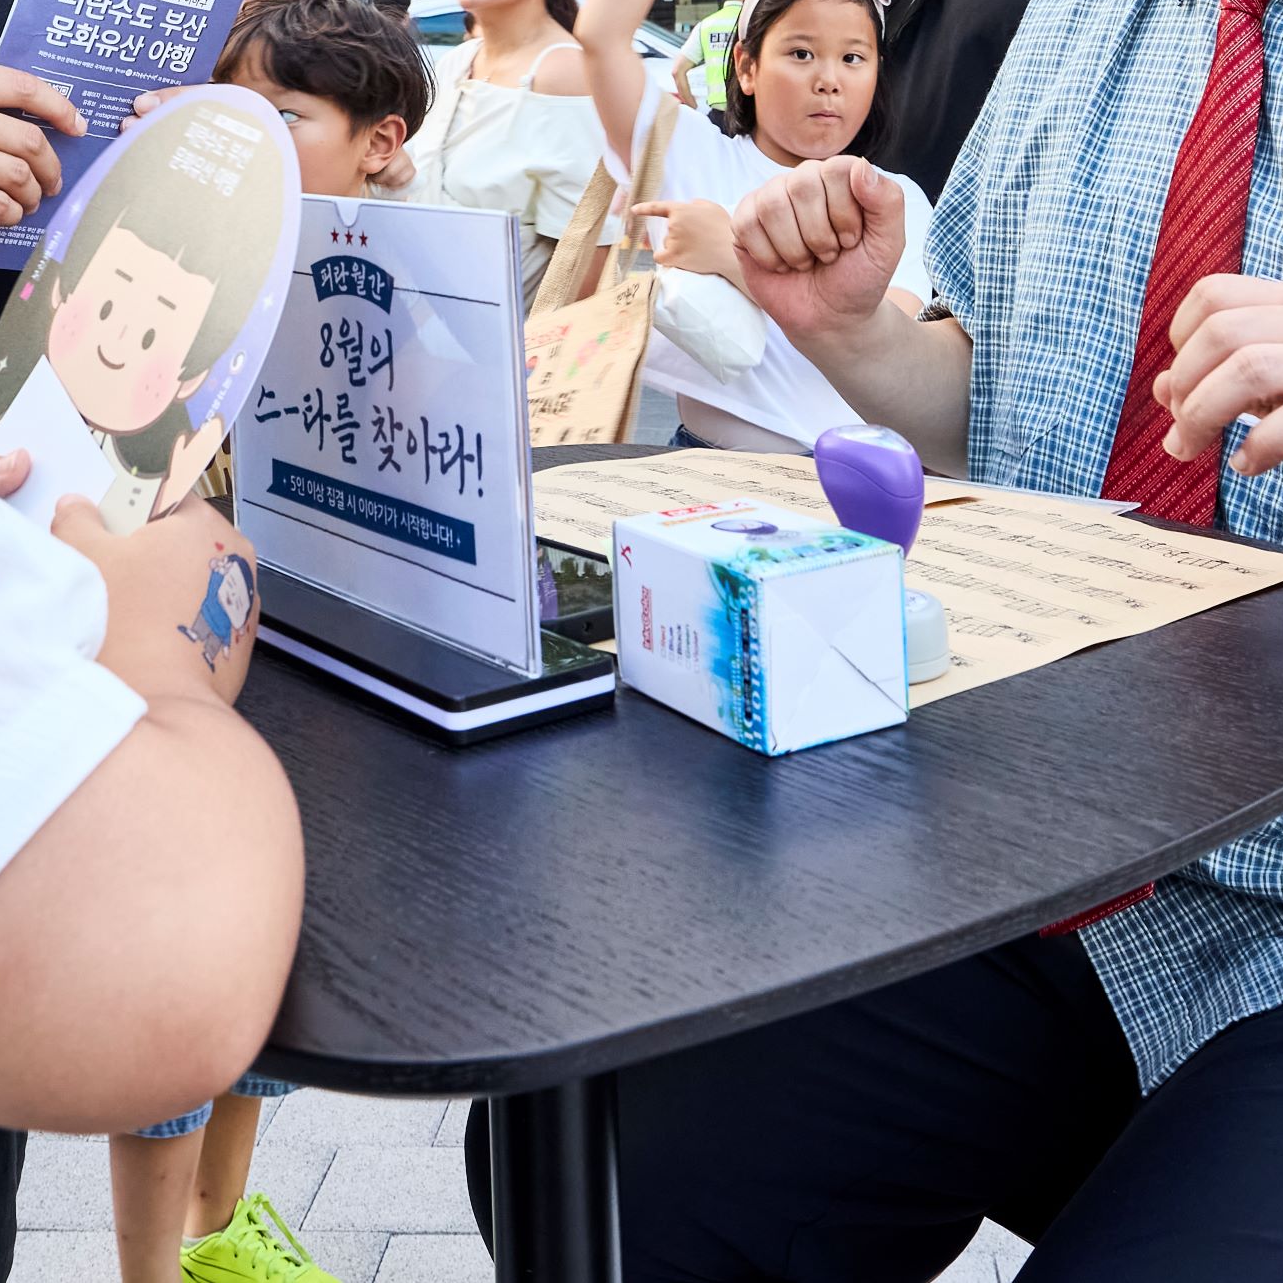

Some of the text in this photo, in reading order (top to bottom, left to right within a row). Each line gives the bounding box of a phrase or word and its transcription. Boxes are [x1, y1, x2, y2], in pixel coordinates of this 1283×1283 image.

[45, 15, 196, 73] 문화유산 야행
[159, 9, 207, 42] 부산
[319, 317, 395, 391] 8월의
[371, 404, 484, 498] 찾아라!
[290, 475, 454, 548] 5인 이상 집결 시 이야기가 시작합니다!
